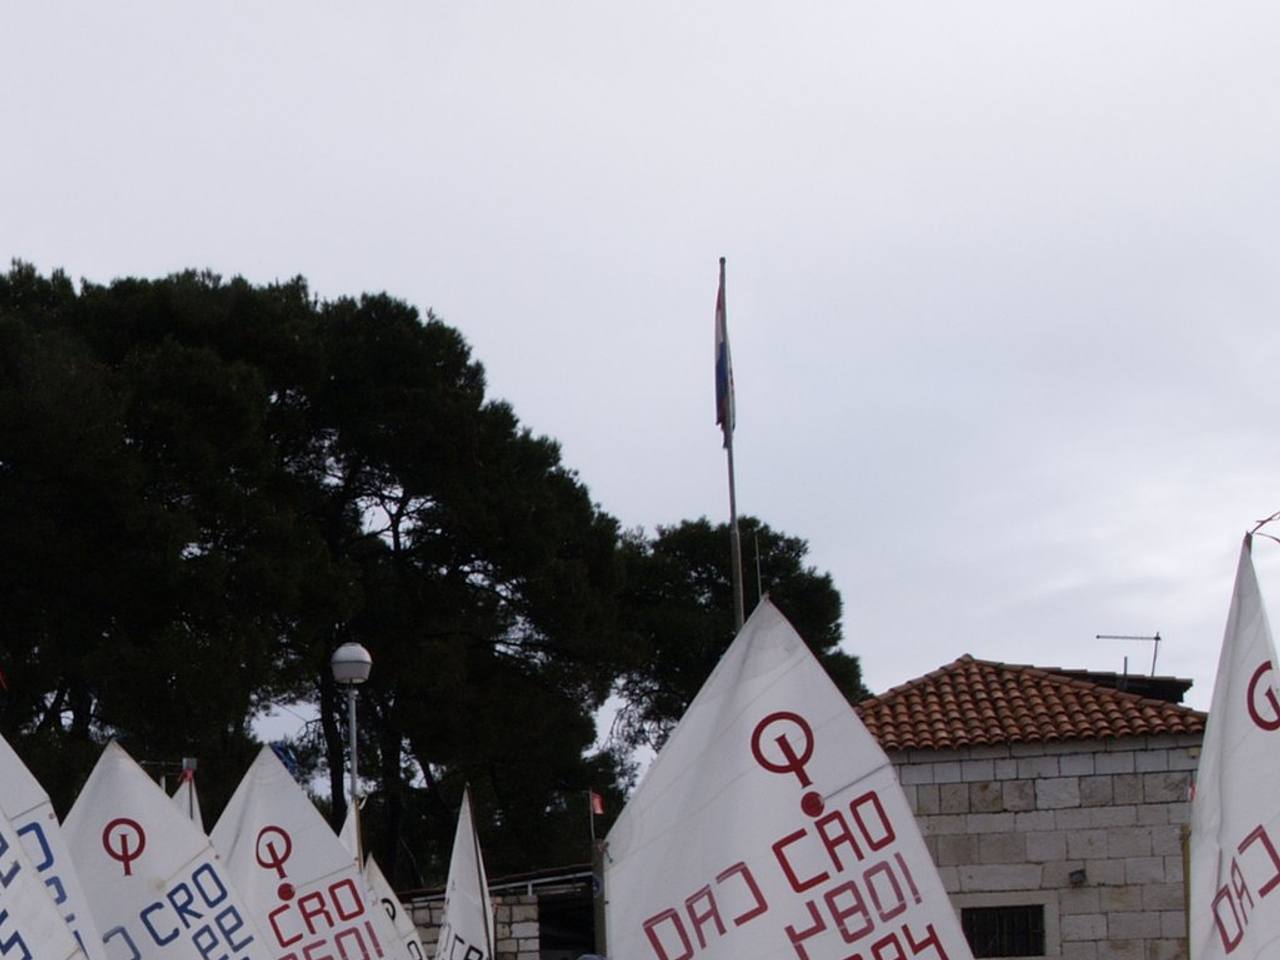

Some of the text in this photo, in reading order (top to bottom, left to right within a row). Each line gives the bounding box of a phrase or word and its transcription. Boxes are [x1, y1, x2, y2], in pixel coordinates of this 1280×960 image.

[771, 789, 896, 893] CRO
[140, 863, 228, 947] CRO
[269, 878, 365, 948] CRO
